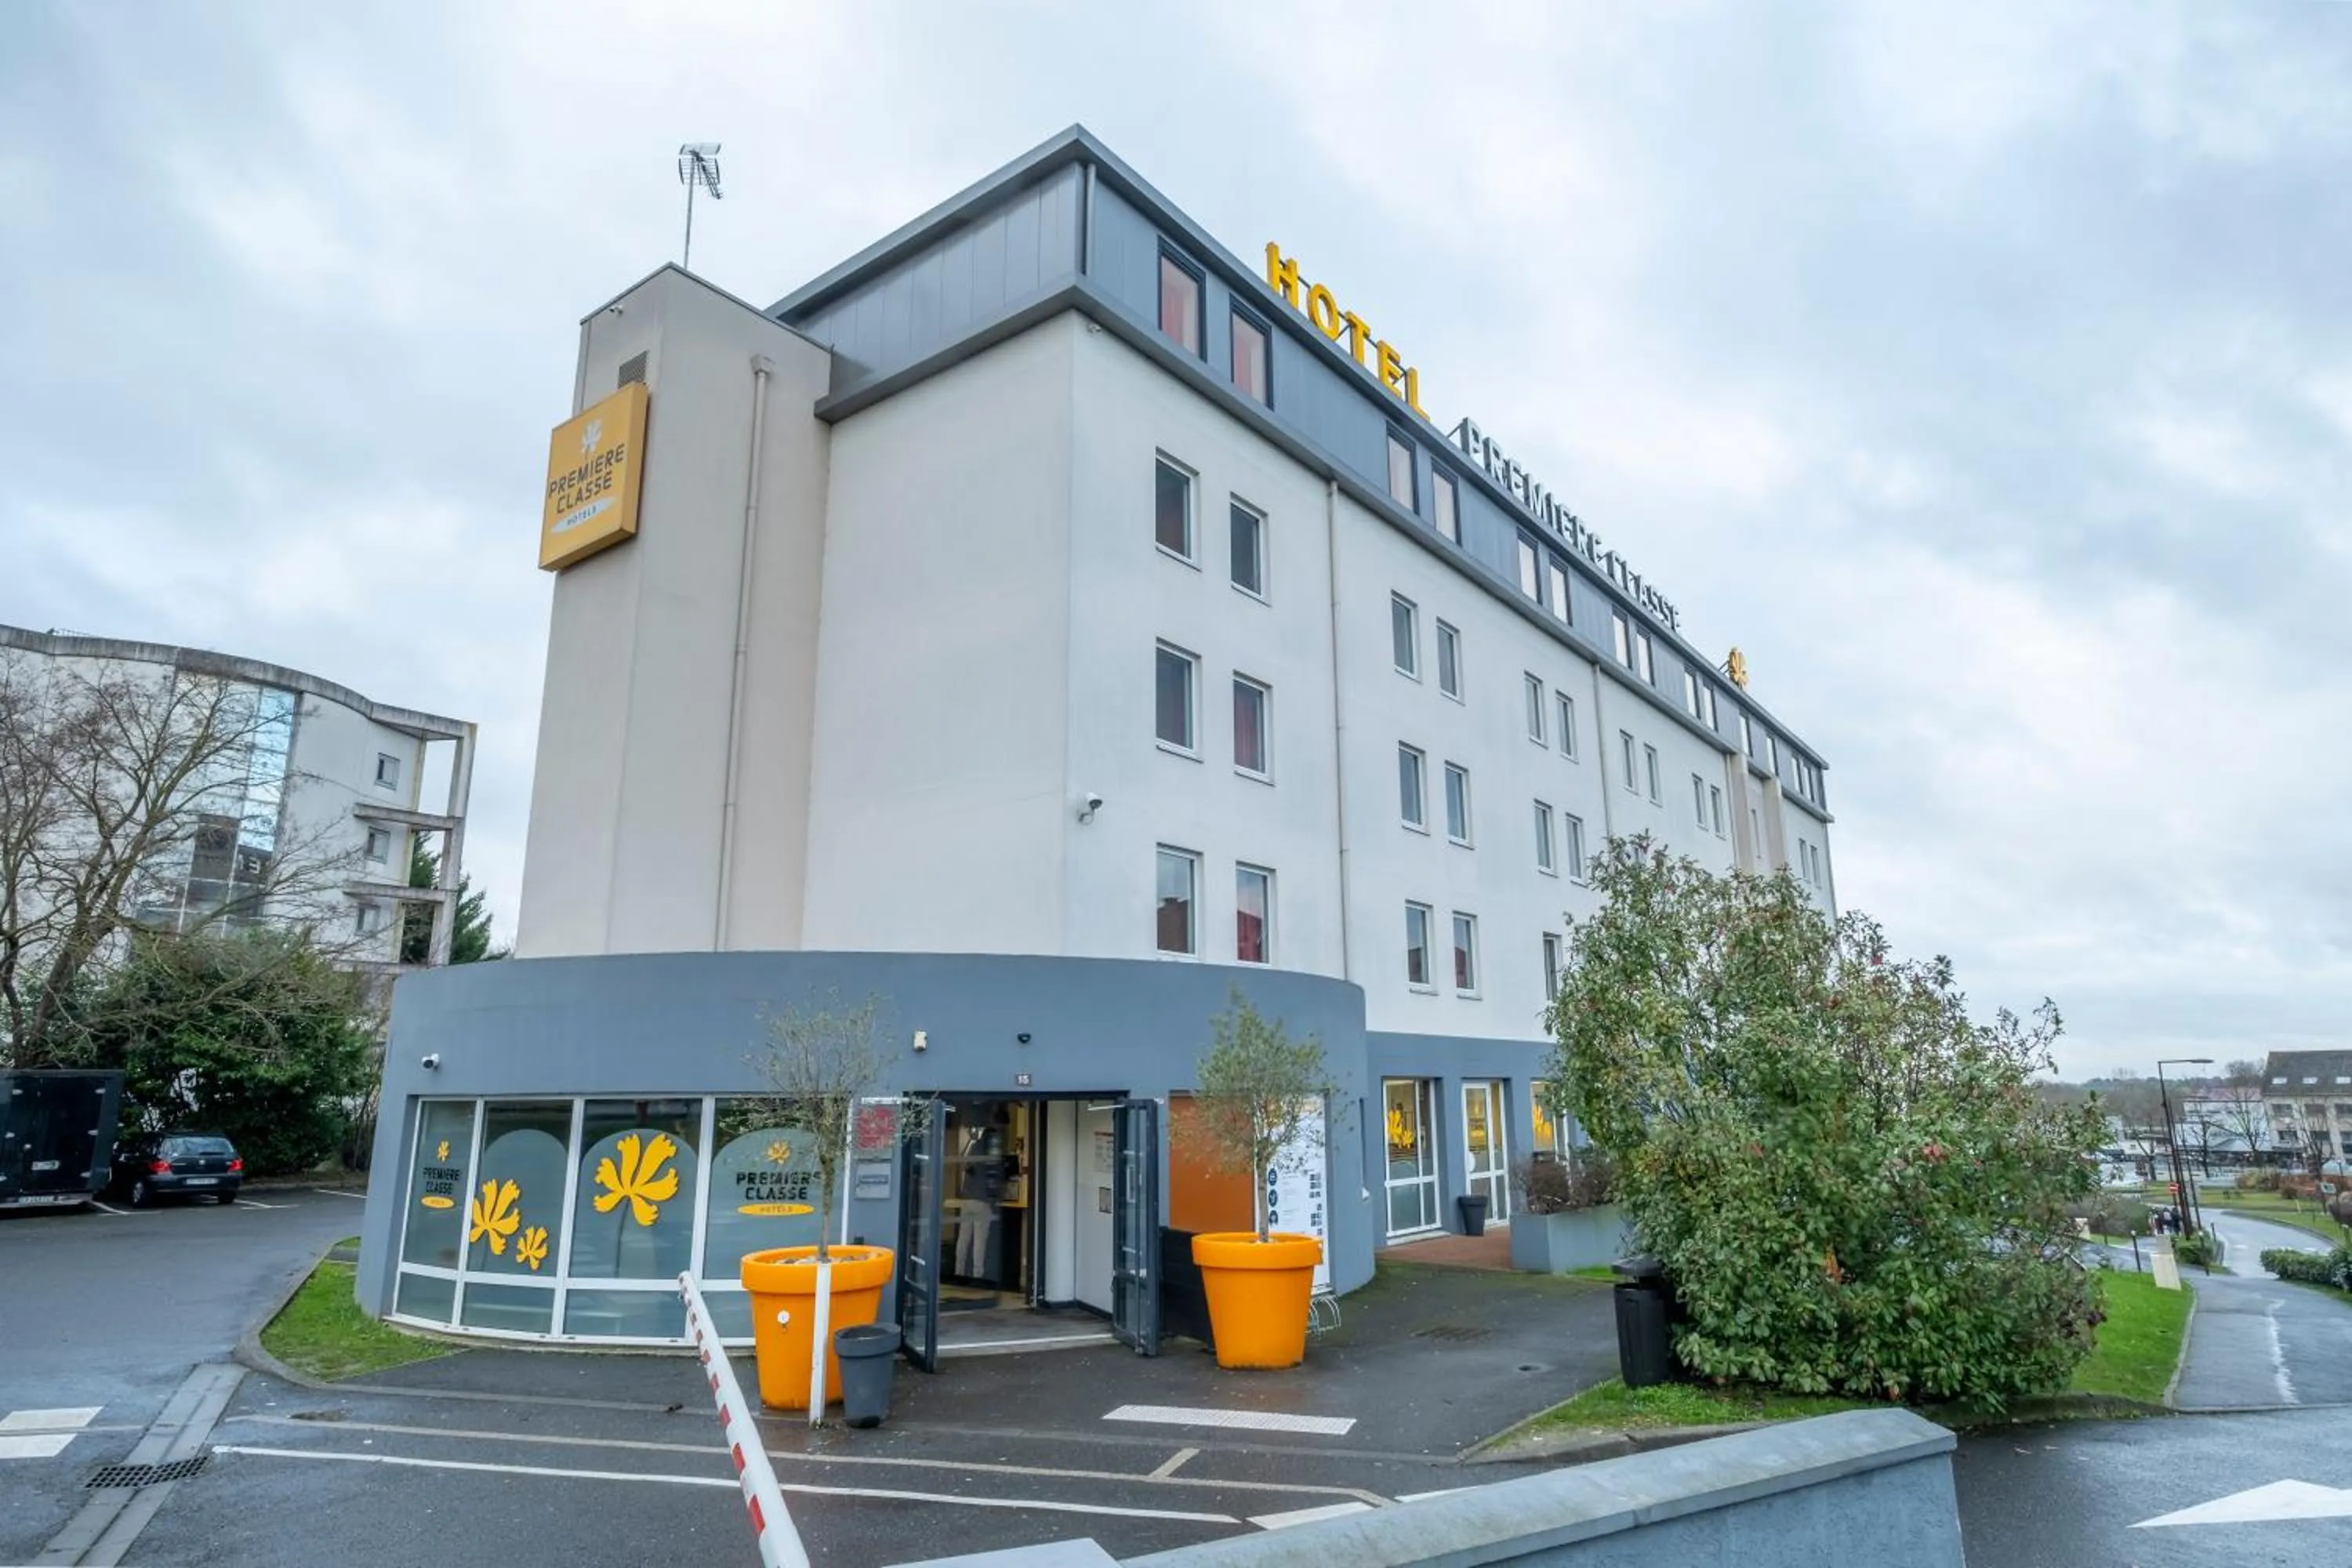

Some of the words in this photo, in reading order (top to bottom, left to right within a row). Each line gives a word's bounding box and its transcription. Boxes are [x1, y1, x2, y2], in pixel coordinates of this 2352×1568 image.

[1266, 241, 1431, 423] HOTEL
[548, 443, 626, 499] PREMIERE
[557, 470, 613, 514] CLASSE
[1460, 416, 1603, 565] PREMIERE
[746, 1186, 808, 1200] CLASSE
